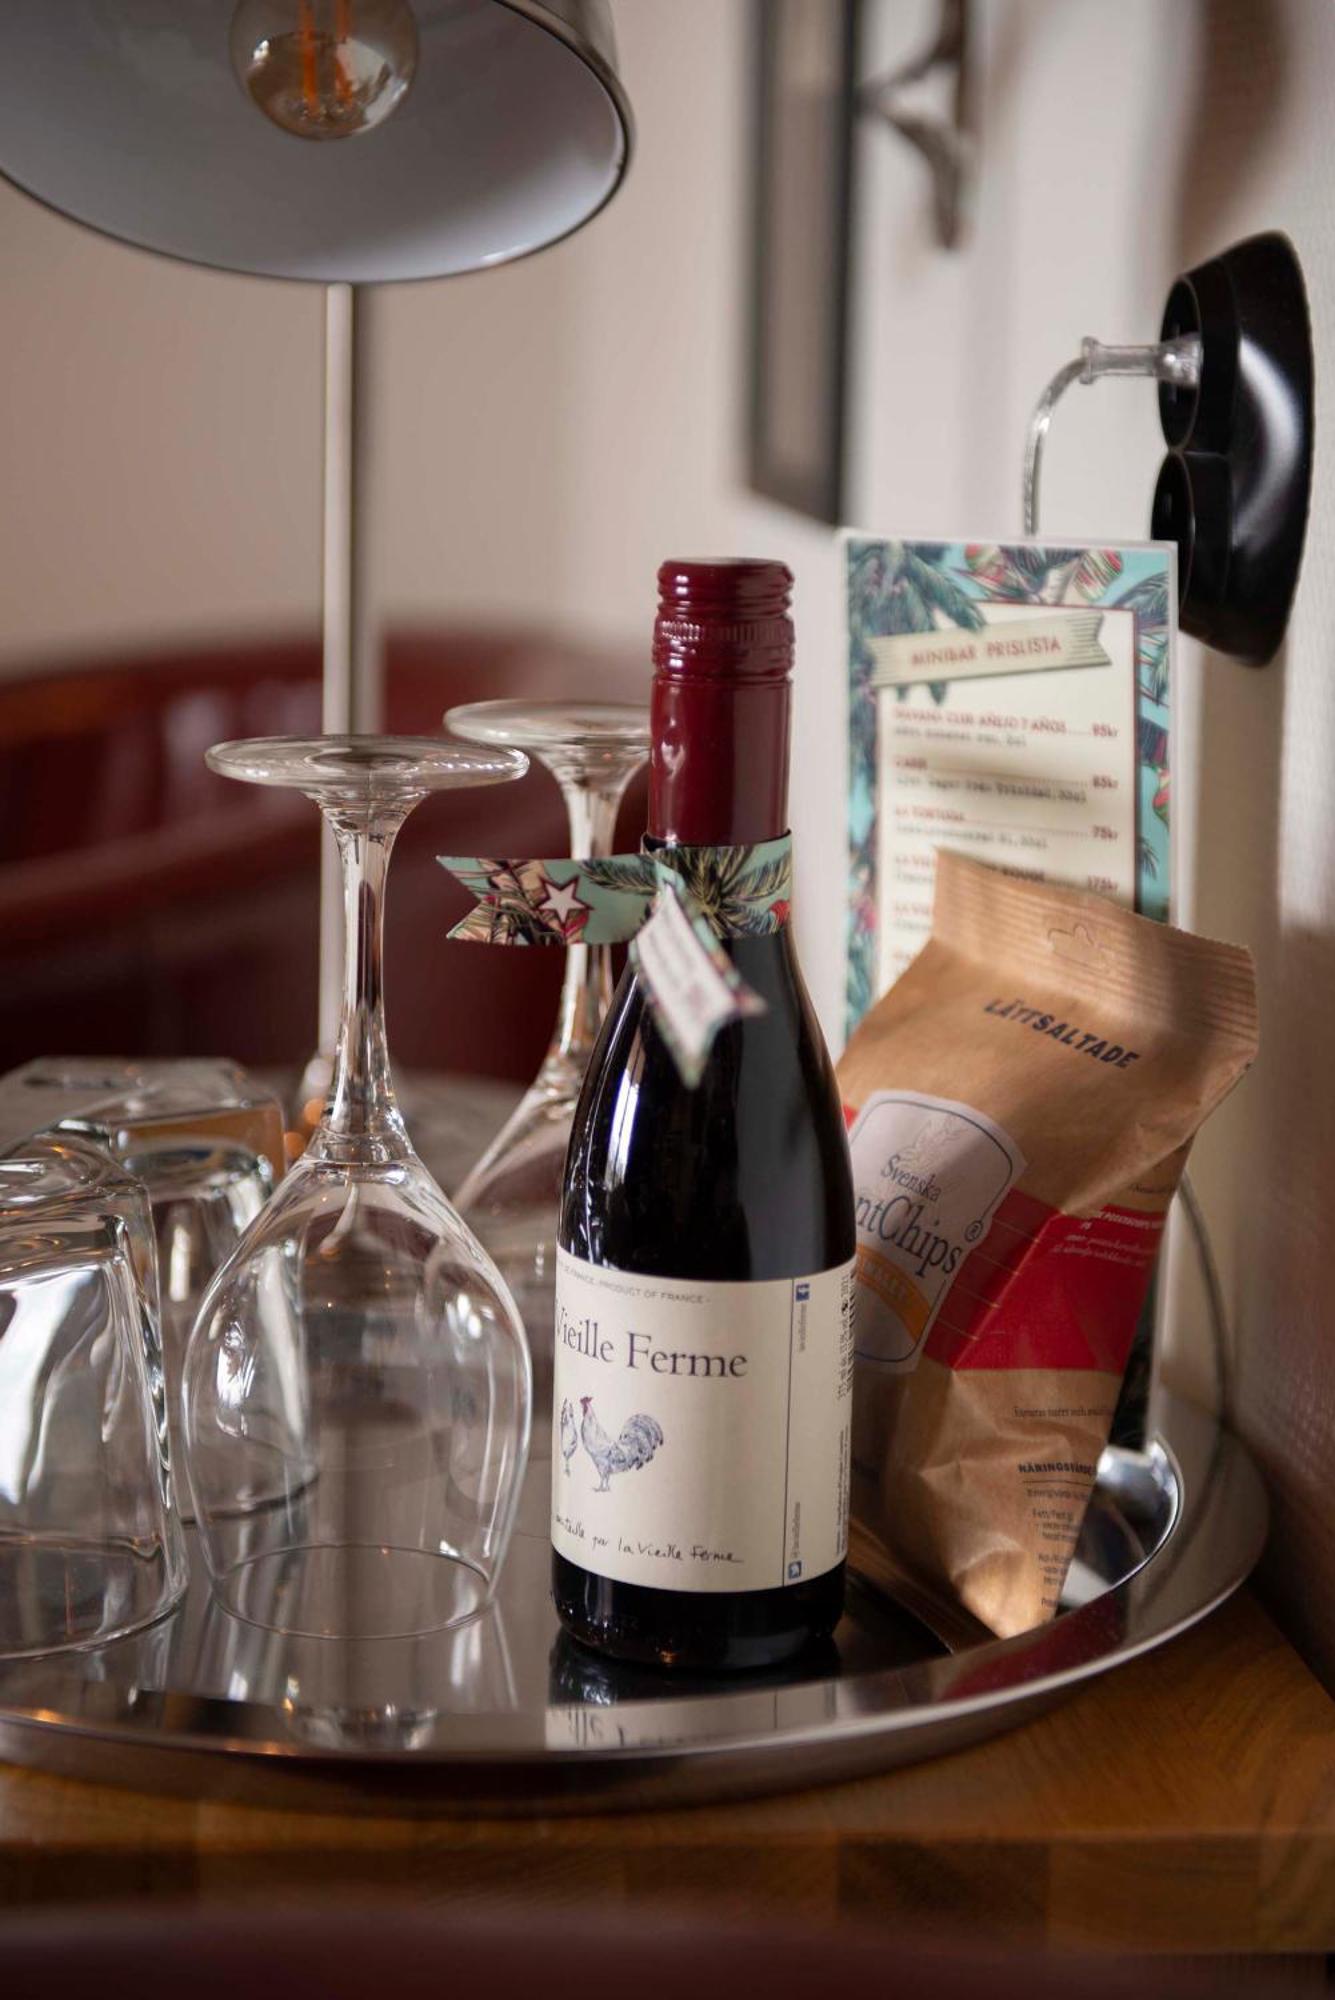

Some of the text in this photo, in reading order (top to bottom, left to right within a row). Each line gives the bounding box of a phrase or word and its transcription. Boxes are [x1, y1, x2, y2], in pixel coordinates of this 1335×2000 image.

[986, 636, 1063, 657] PRISLISTA
[984, 999, 1141, 1068] LÄTTSALTADE
[881, 1154, 942, 1202] Svenska
[659, 1291, 704, 1305] FRANCE
[555, 1307, 749, 1378] Vieille Ferme
[690, 1545, 745, 1564] Ferme
